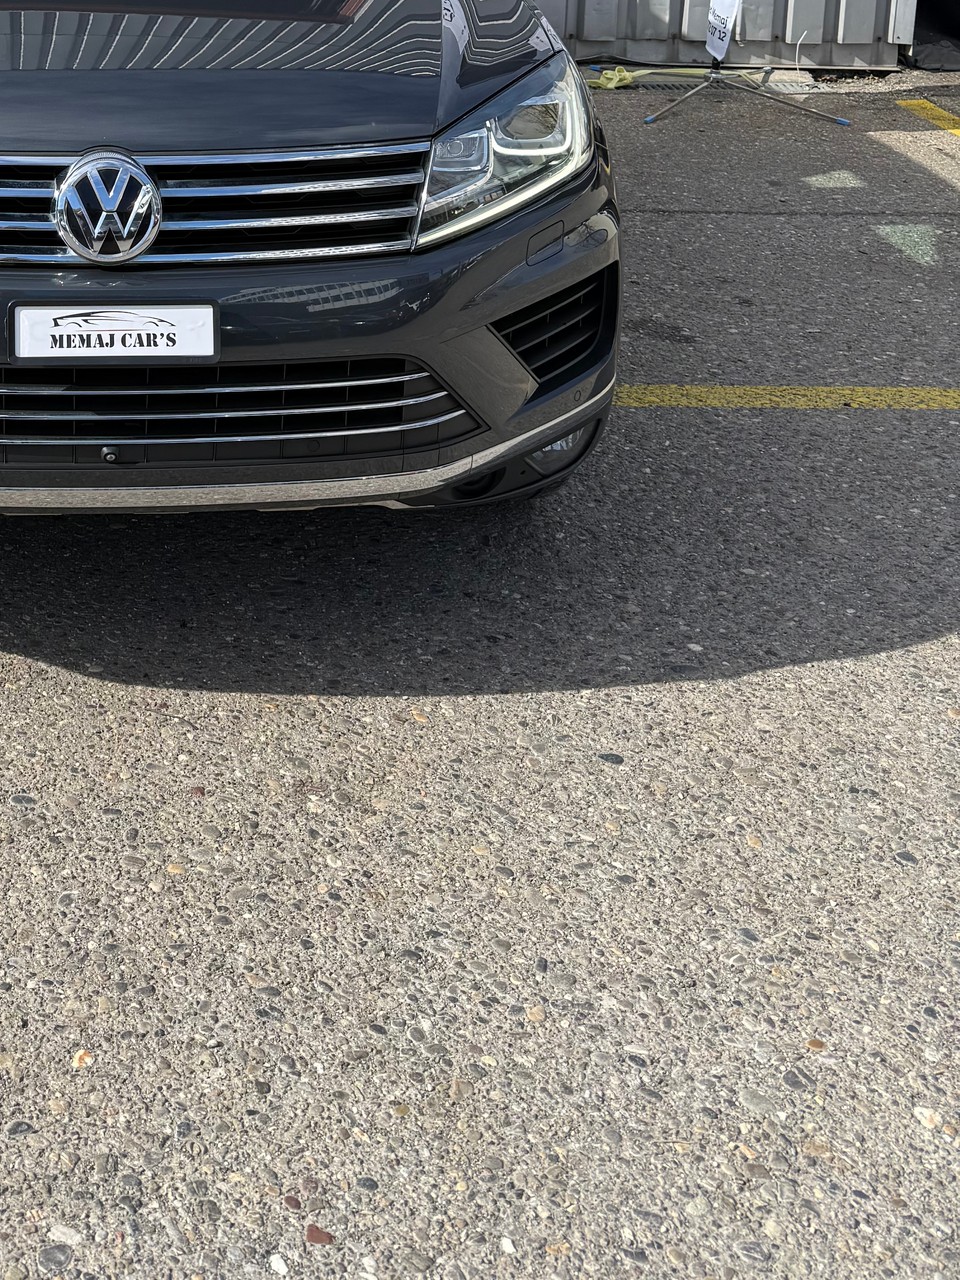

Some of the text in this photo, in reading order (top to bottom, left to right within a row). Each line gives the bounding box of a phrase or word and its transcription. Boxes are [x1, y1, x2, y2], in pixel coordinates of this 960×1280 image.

[718, 29, 727, 42] 12
[50, 333, 176, 348] MEMAJ CAR'S
